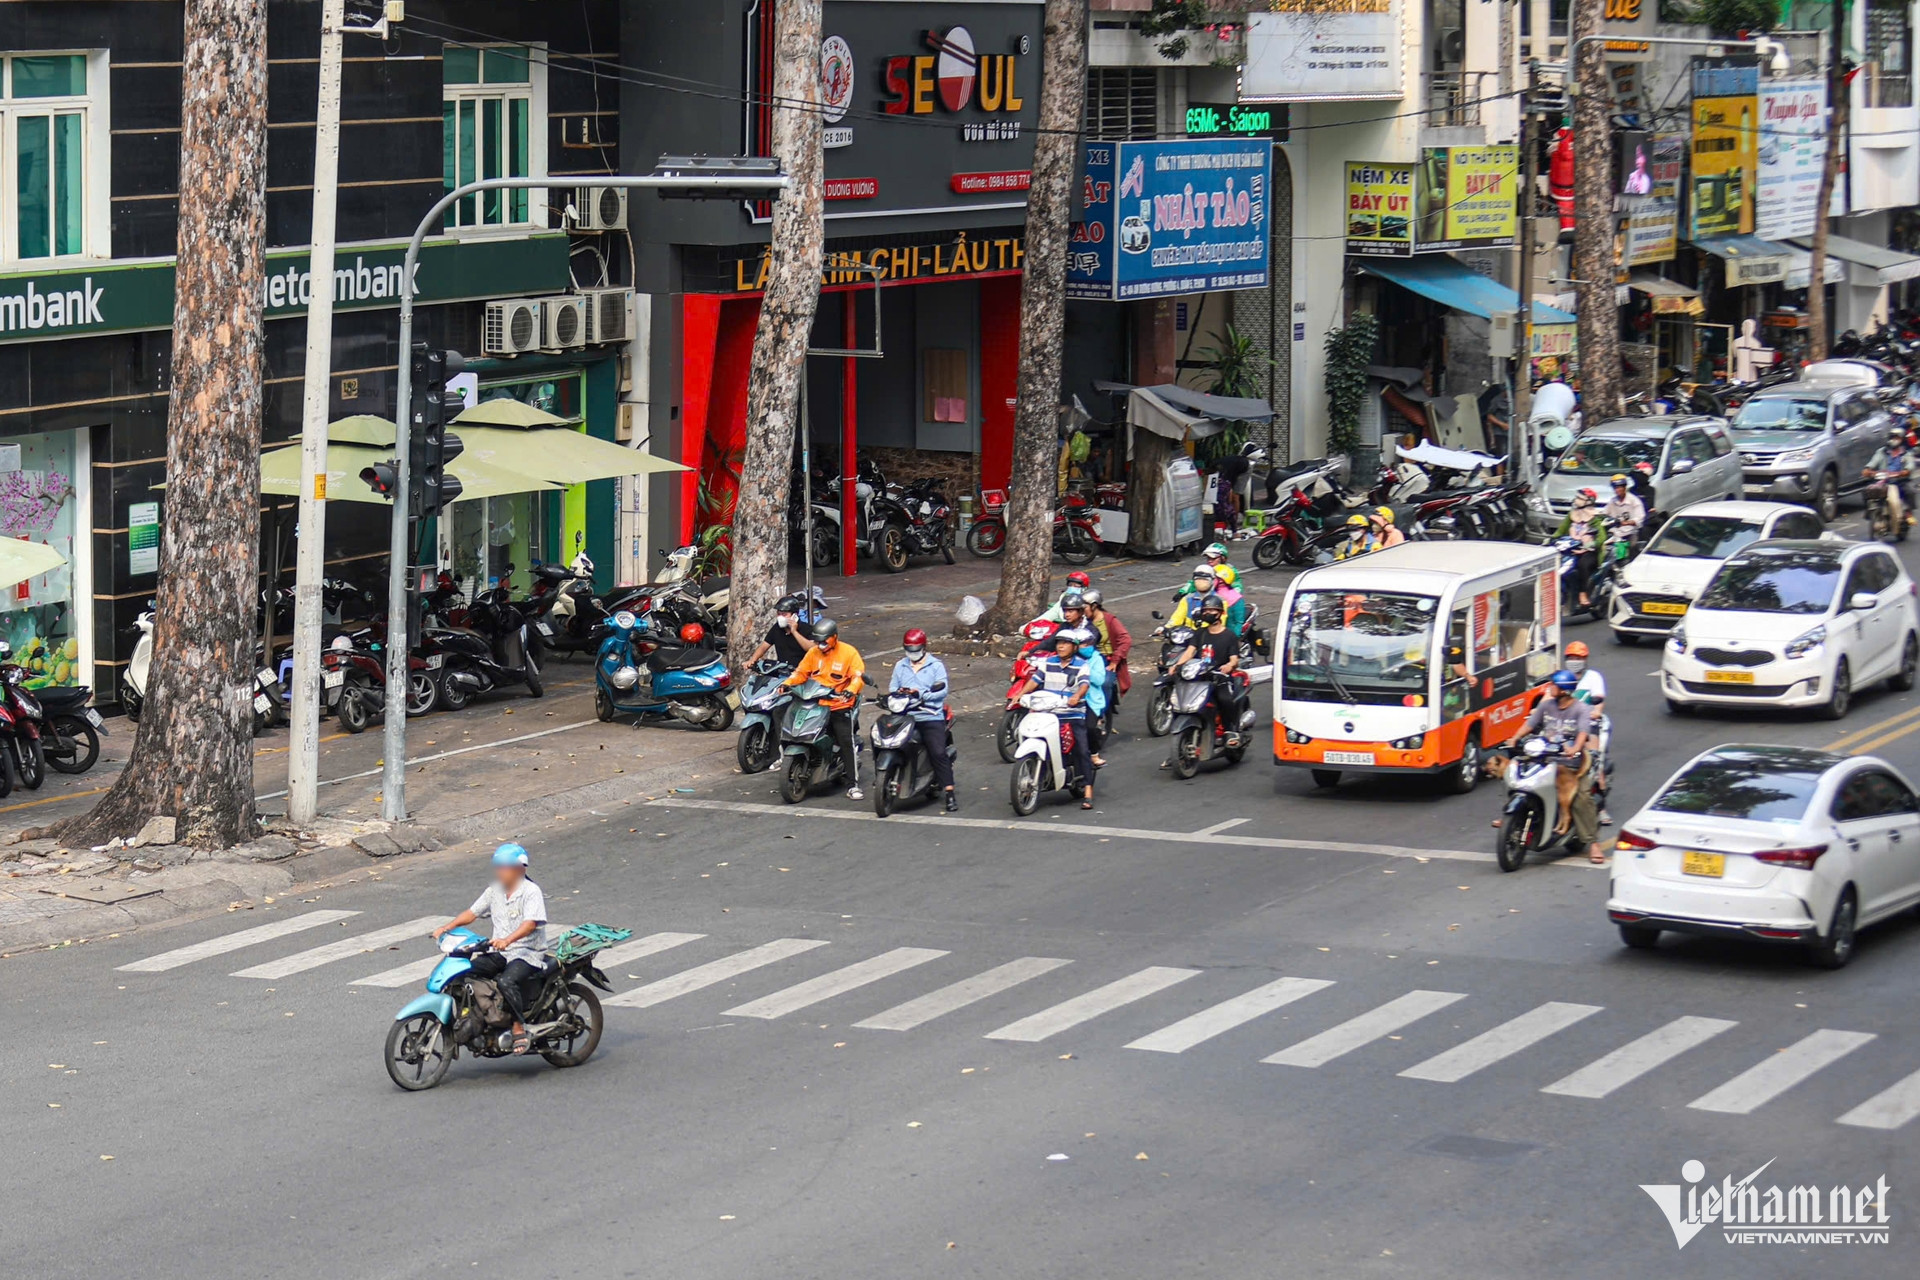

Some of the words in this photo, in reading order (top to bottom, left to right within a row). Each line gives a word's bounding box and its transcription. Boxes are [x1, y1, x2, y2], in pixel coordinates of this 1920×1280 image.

[835, 131, 852, 143] 2016
[1088, 149, 1110, 166] XE
[961, 174, 988, 189] Hotline:
[1389, 168, 1410, 185] XE
[1083, 174, 1111, 208] ẬT
[1153, 182, 1208, 239] NHẬT
[1211, 176, 1250, 228] TẢO
[1388, 191, 1409, 211] ÚT
[736, 243, 772, 291] LẨ
[264, 255, 421, 308] etcmbank
[235, 687, 252, 701] 112
